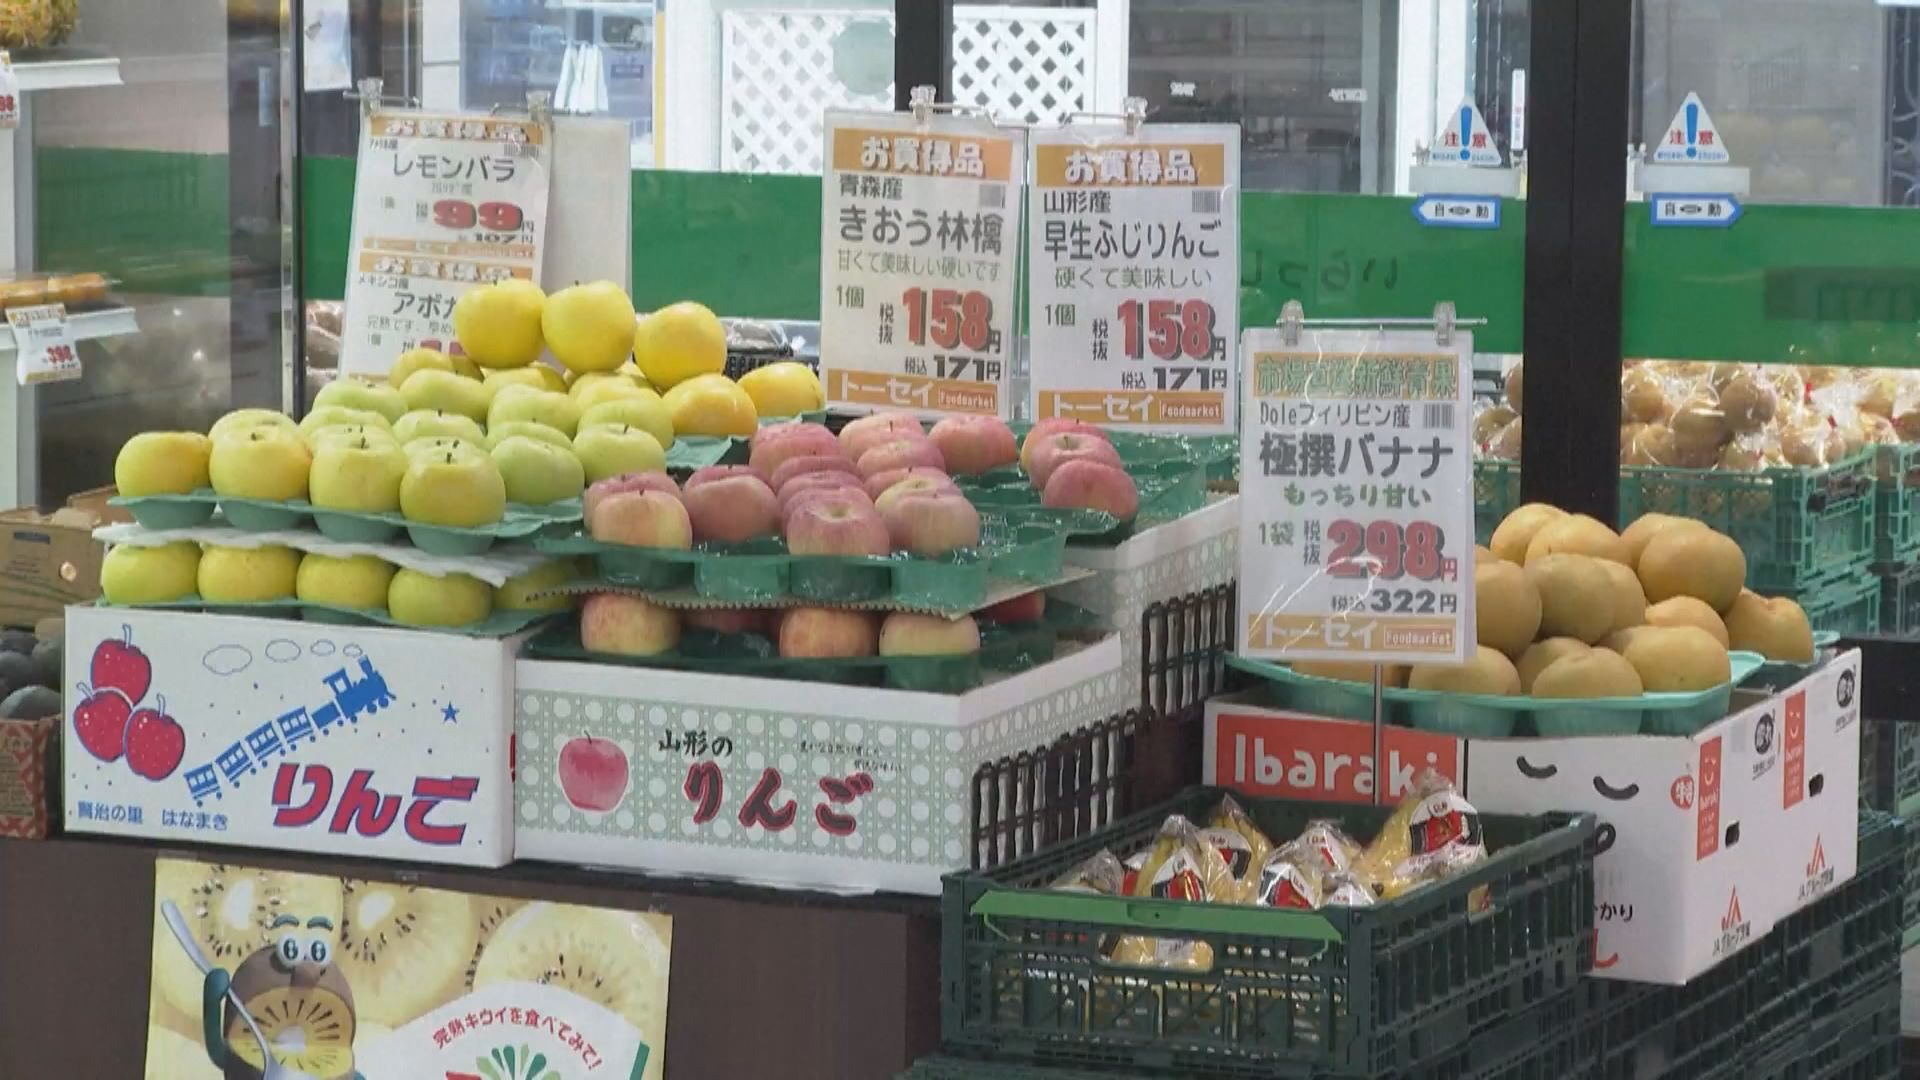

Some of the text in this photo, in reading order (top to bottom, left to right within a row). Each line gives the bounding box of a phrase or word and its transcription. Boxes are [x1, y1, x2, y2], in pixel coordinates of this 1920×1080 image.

[393, 153, 516, 182] レモンバラ
[860, 135, 986, 178] お買得品
[1064, 148, 1197, 185] お買得品
[838, 174, 904, 201] 青森産
[1043, 190, 1112, 215] 山形産
[838, 205, 1005, 256] きおう林檎
[1044, 219, 1223, 262] 早生ふじりんご
[837, 248, 1001, 282] 甘くて美味しい硬いです
[1055, 266, 1213, 290] 硬くて美味しい
[836, 285, 865, 309] 1個
[879, 302, 894, 345] 税抜
[1044, 304, 1076, 327] 1個
[1092, 318, 1109, 361] 税抜
[841, 372, 935, 409] トーセイ
[1053, 393, 1155, 423] トーセイ
[1258, 430, 1455, 479] 極撰バナナ
[1283, 482, 1432, 509] もっちり甘い
[1258, 521, 1295, 547] 1袋
[1303, 519, 1322, 568] 税抜
[1265, 618, 1378, 650] トーセイ
[657, 728, 734, 759] 山形の
[1234, 732, 1439, 798] Ibarak
[271, 760, 481, 847] りんご
[683, 759, 875, 836] りんご
[77, 799, 228, 831] 賢治の里 はなまき
[1594, 900, 1634, 923] かり
